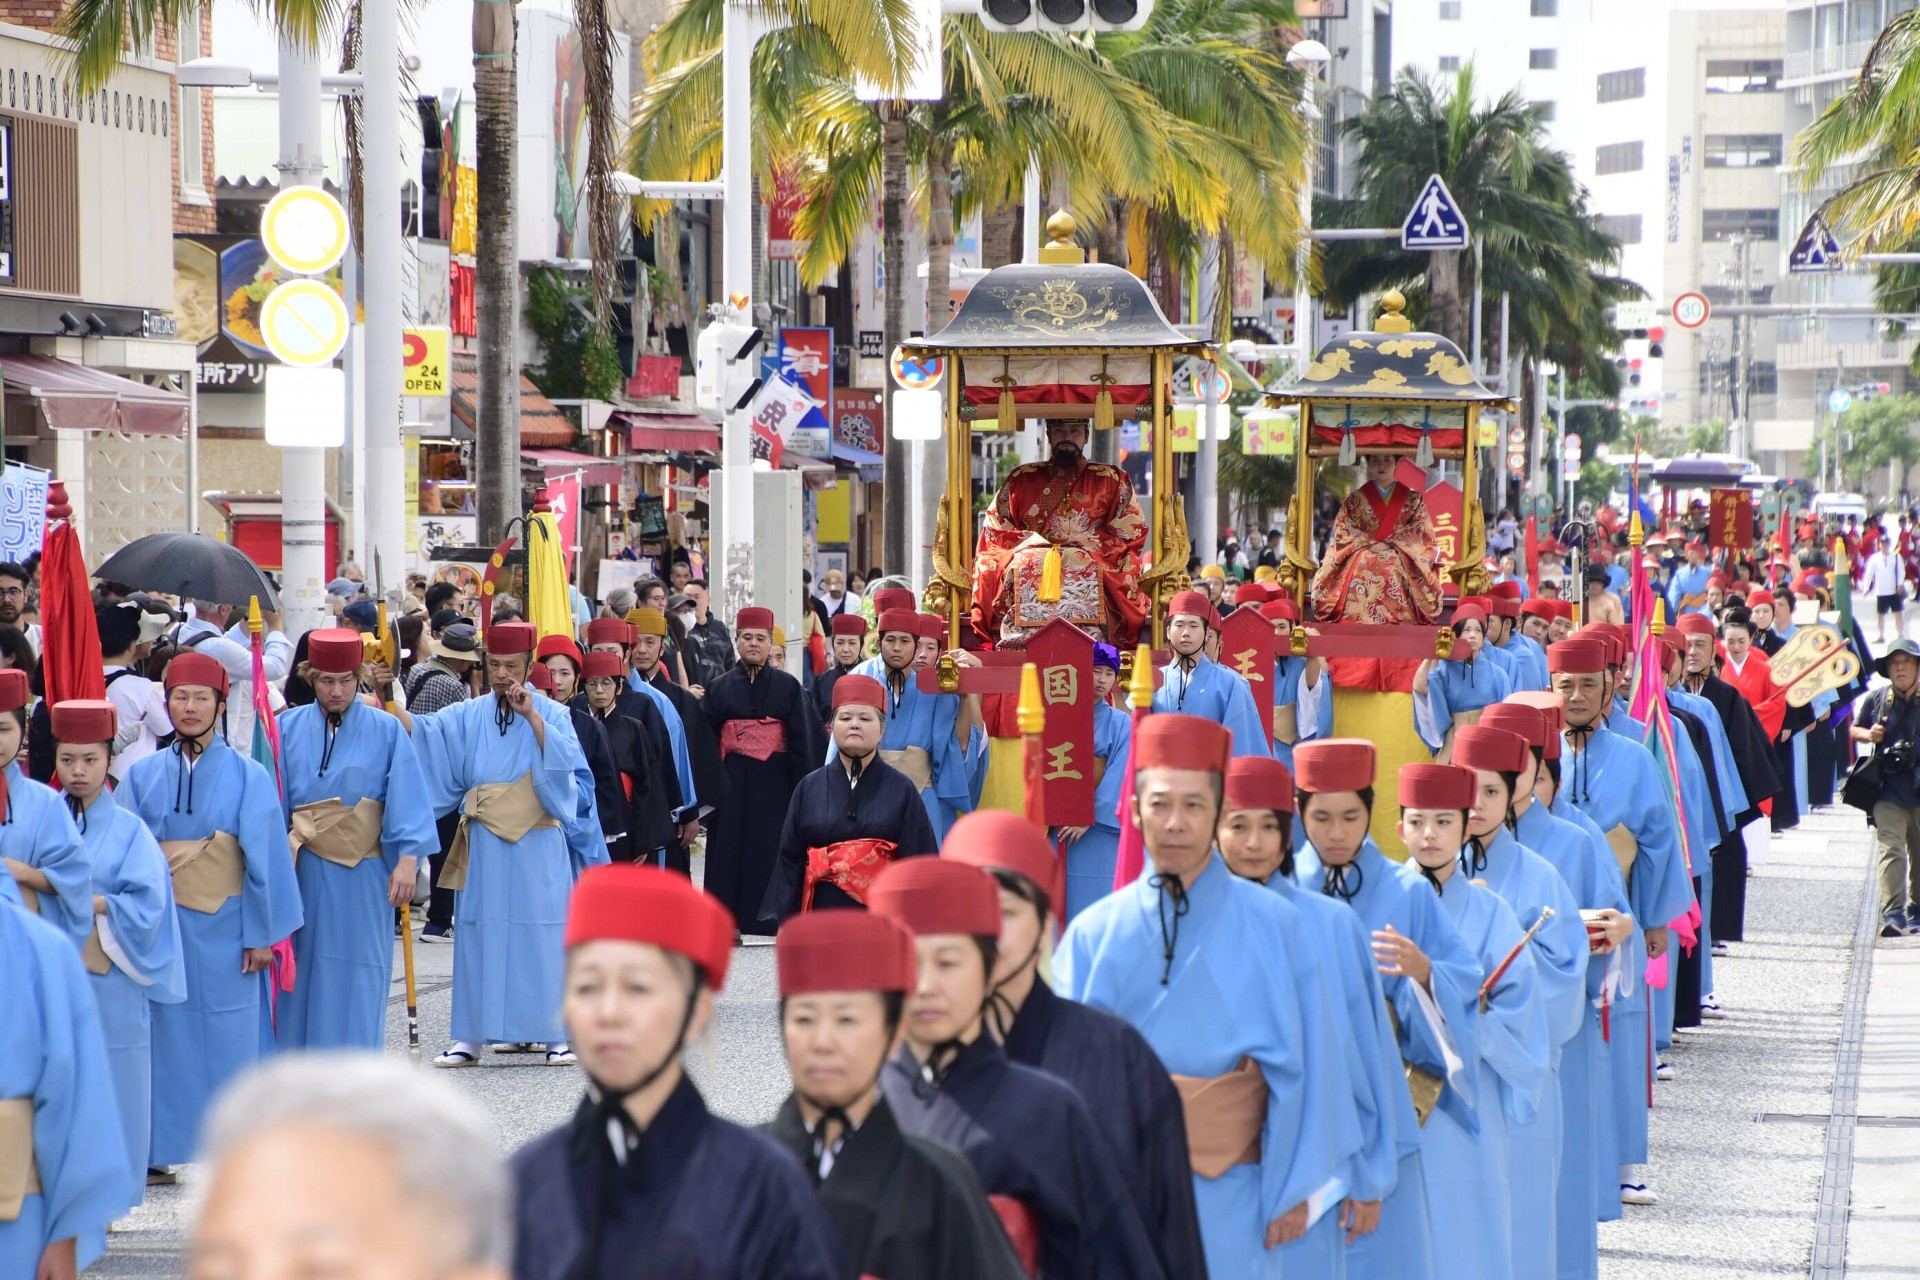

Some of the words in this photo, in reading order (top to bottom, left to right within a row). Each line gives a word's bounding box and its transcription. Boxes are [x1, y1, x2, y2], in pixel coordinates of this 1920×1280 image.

[1681, 302, 1702, 319] 30
[862, 334, 882, 344] TEL
[196, 362, 265, 385] 所アリ
[421, 365, 439, 378] 24
[405, 379, 442, 391] OPEN
[1433, 512, 1458, 585] 三司官
[1233, 648, 1265, 682] 王
[1043, 664, 1083, 781] 国王
